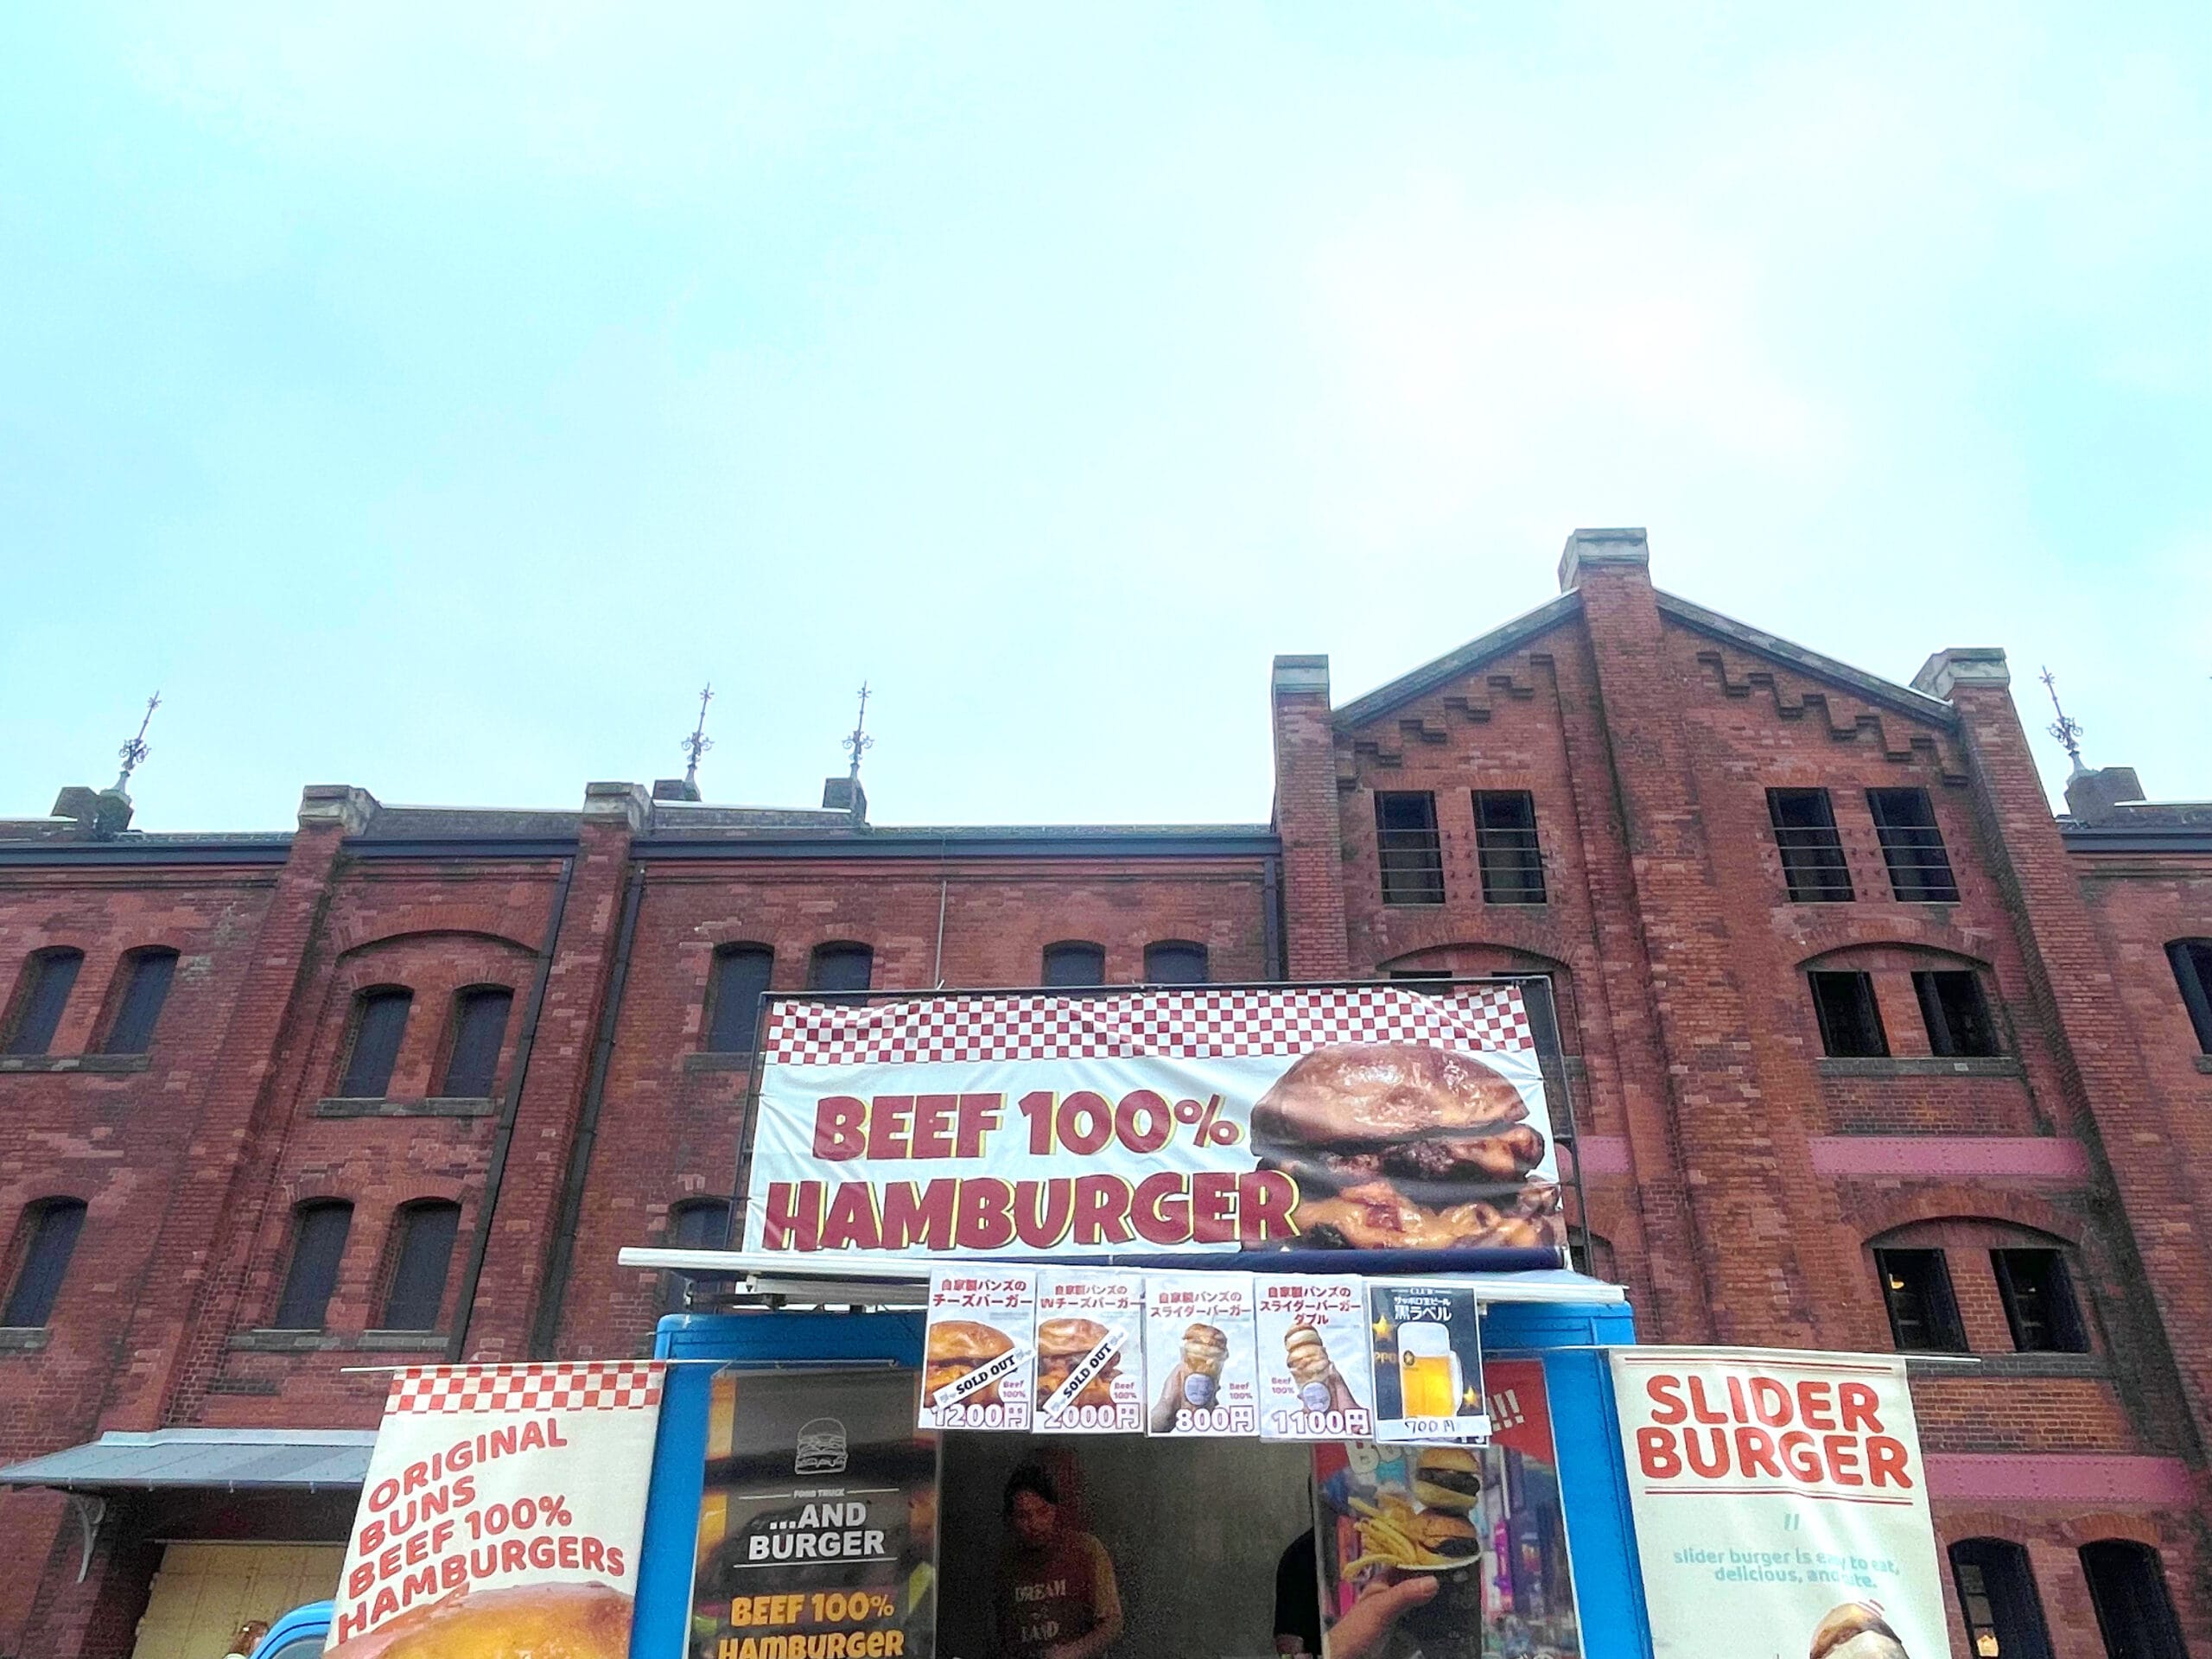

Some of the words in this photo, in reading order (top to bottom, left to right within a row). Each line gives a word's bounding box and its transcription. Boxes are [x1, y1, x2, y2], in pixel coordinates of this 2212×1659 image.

[813, 1093, 1007, 1161] BEEF
[1018, 1090, 1245, 1155] 100%
[762, 1170, 1301, 1251] HAMBURGER
[942, 1279, 1027, 1292] 自家製バンズの
[1054, 1284, 1128, 1296] 自家製バンズの
[1159, 1291, 1242, 1304] 自家製バンズの
[1268, 1286, 1351, 1298] 自家製バンズの
[932, 1294, 1033, 1308] チーズバーガー
[1150, 1304, 1252, 1318] スライダーバーガー
[1260, 1299, 1361, 1313] スライダーバーガー
[1395, 1305, 1452, 1322] 黒ラベル
[1294, 1313, 1329, 1325] ダブル
[956, 1370, 988, 1395] SOLD
[990, 1354, 1016, 1376] OUT
[1063, 1368, 1094, 1400] SOLD
[1090, 1344, 1112, 1370] OUT
[1114, 1382, 1135, 1390] Beef
[1230, 1382, 1249, 1391] Beef
[931, 1401, 1028, 1428] 1200円
[1044, 1402, 1141, 1430] 2000円
[1646, 1375, 1885, 1433] SLIDER
[1175, 1405, 1254, 1432] 800円
[1272, 1408, 1370, 1434] 1100円
[369, 1418, 568, 1513] ORIGINAL
[1637, 1427, 1913, 1489] BURGER
[359, 1476, 476, 1557] BUNS
[348, 1519, 454, 1599] BEEF
[465, 1495, 572, 1540] 100%
[748, 1530, 885, 1560] BURGER
[1674, 1548, 1723, 1565] slider
[1730, 1548, 1789, 1567] burger
[1796, 1548, 1812, 1565] is
[1850, 1555, 1868, 1570] to
[1715, 1566, 1802, 1583] delicious,
[339, 1536, 625, 1645] HAMBURGERS
[730, 1593, 804, 1627] BEEF
[811, 1591, 894, 1622] 100%
